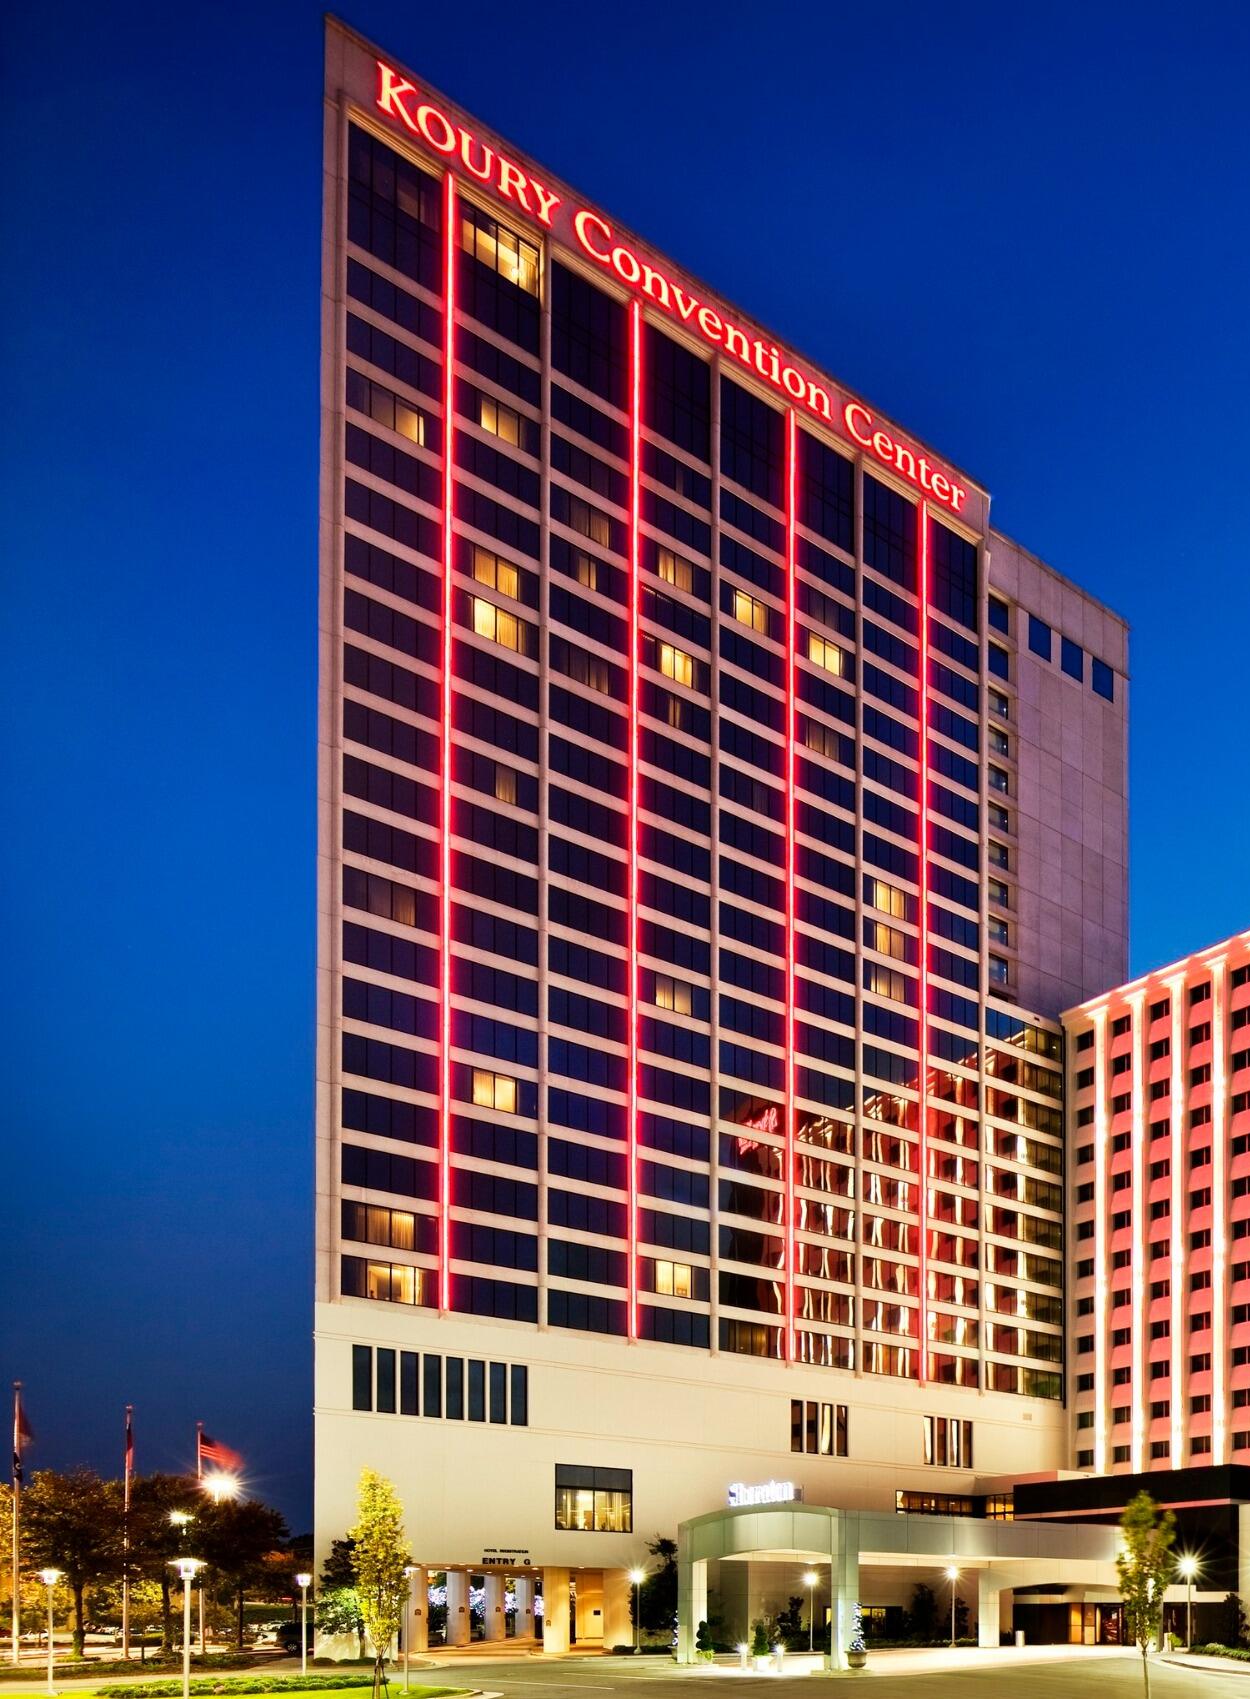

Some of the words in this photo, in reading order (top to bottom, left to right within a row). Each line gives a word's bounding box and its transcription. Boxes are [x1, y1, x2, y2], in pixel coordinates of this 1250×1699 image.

[377, 61, 560, 227] KOURY
[574, 210, 831, 420] Convention
[844, 402, 966, 511] Center
[482, 1557, 516, 1565] ENTRY
[523, 1558, 531, 1566] G
